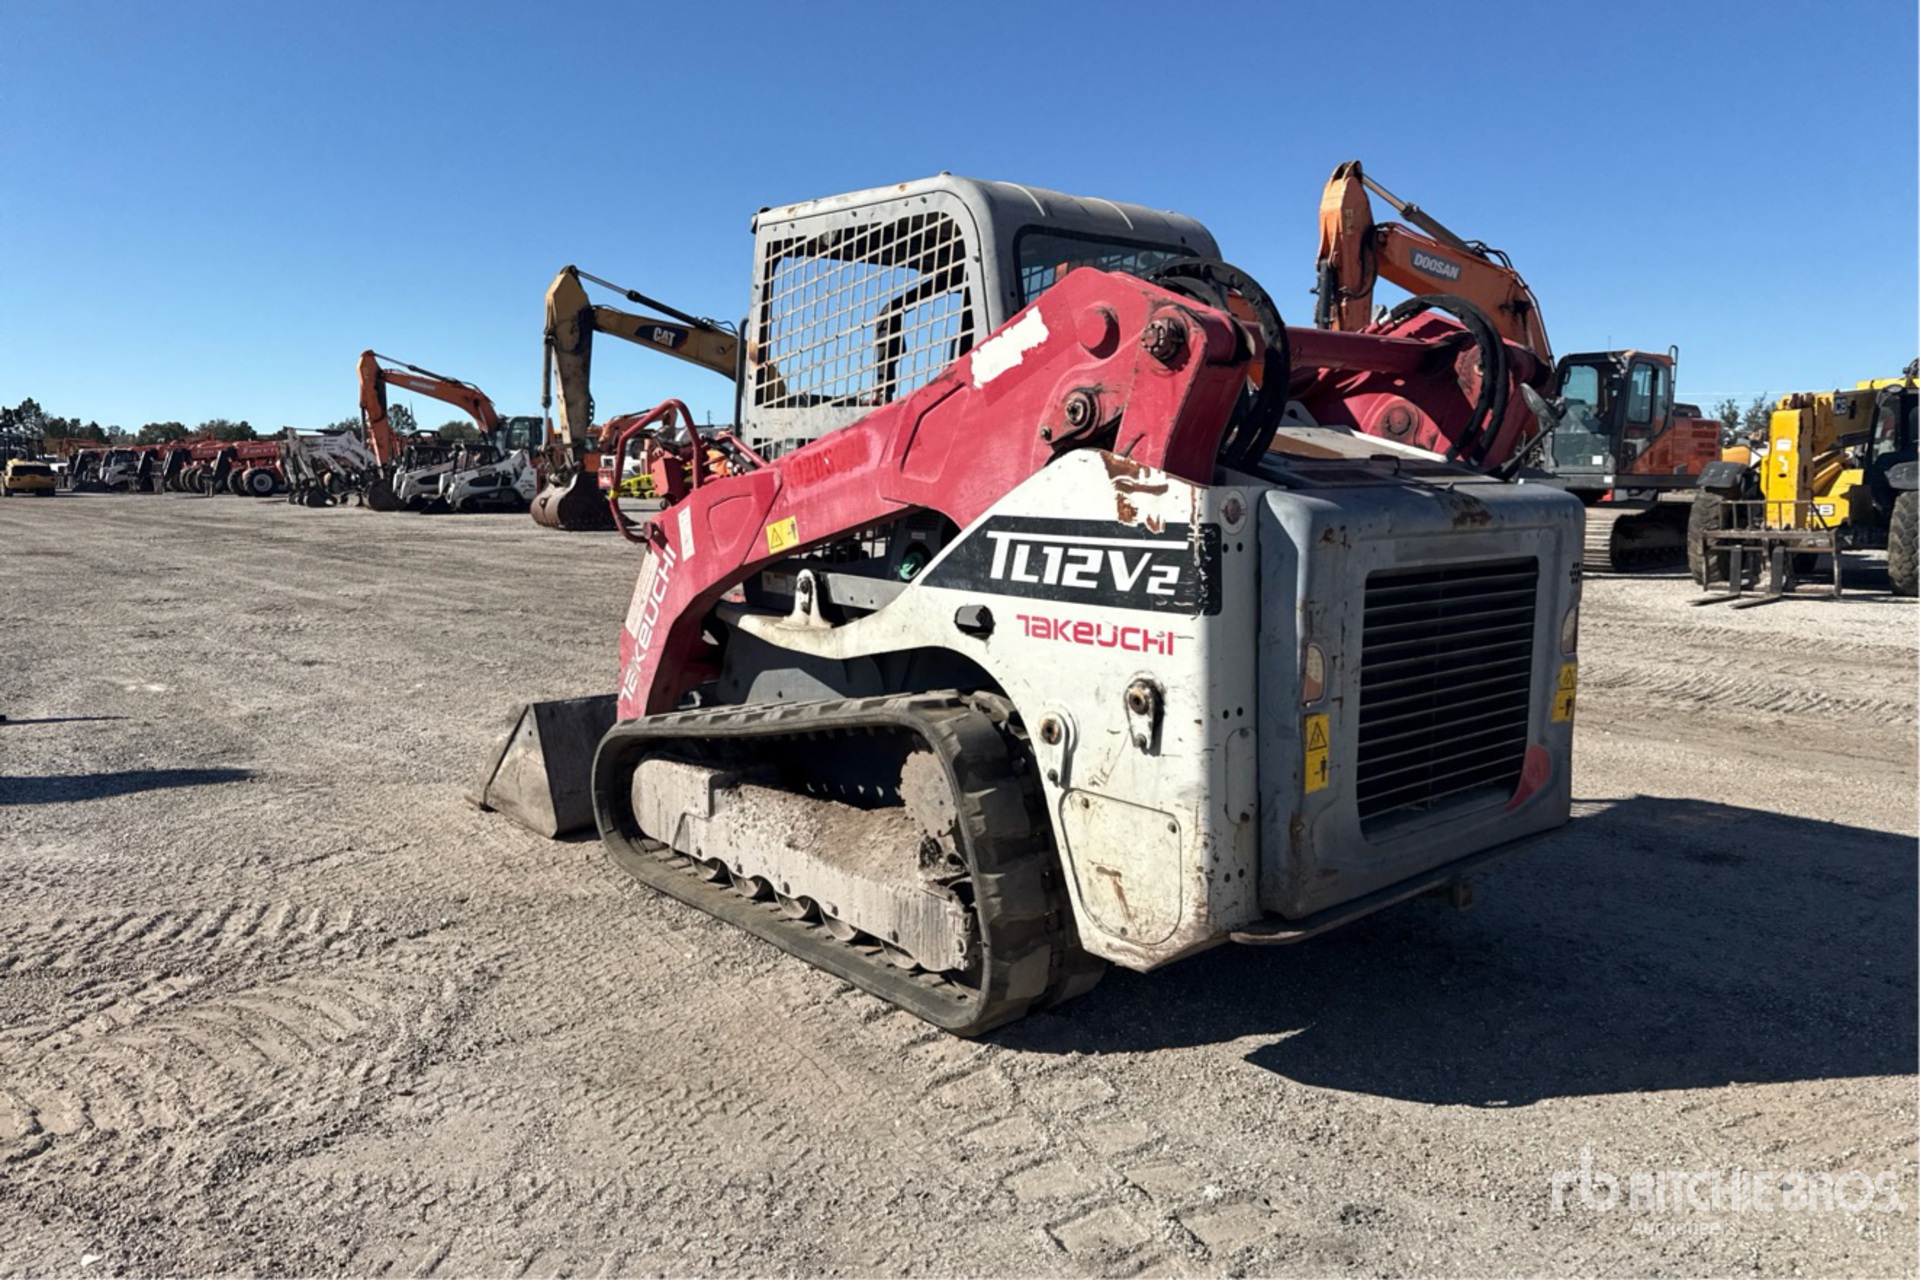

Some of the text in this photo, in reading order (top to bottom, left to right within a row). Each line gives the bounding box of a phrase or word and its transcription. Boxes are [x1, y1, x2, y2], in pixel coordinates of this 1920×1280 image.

[1413, 253, 1460, 279] DOOSAN
[653, 326, 676, 347] CAT
[986, 530, 1189, 596] TL12V2
